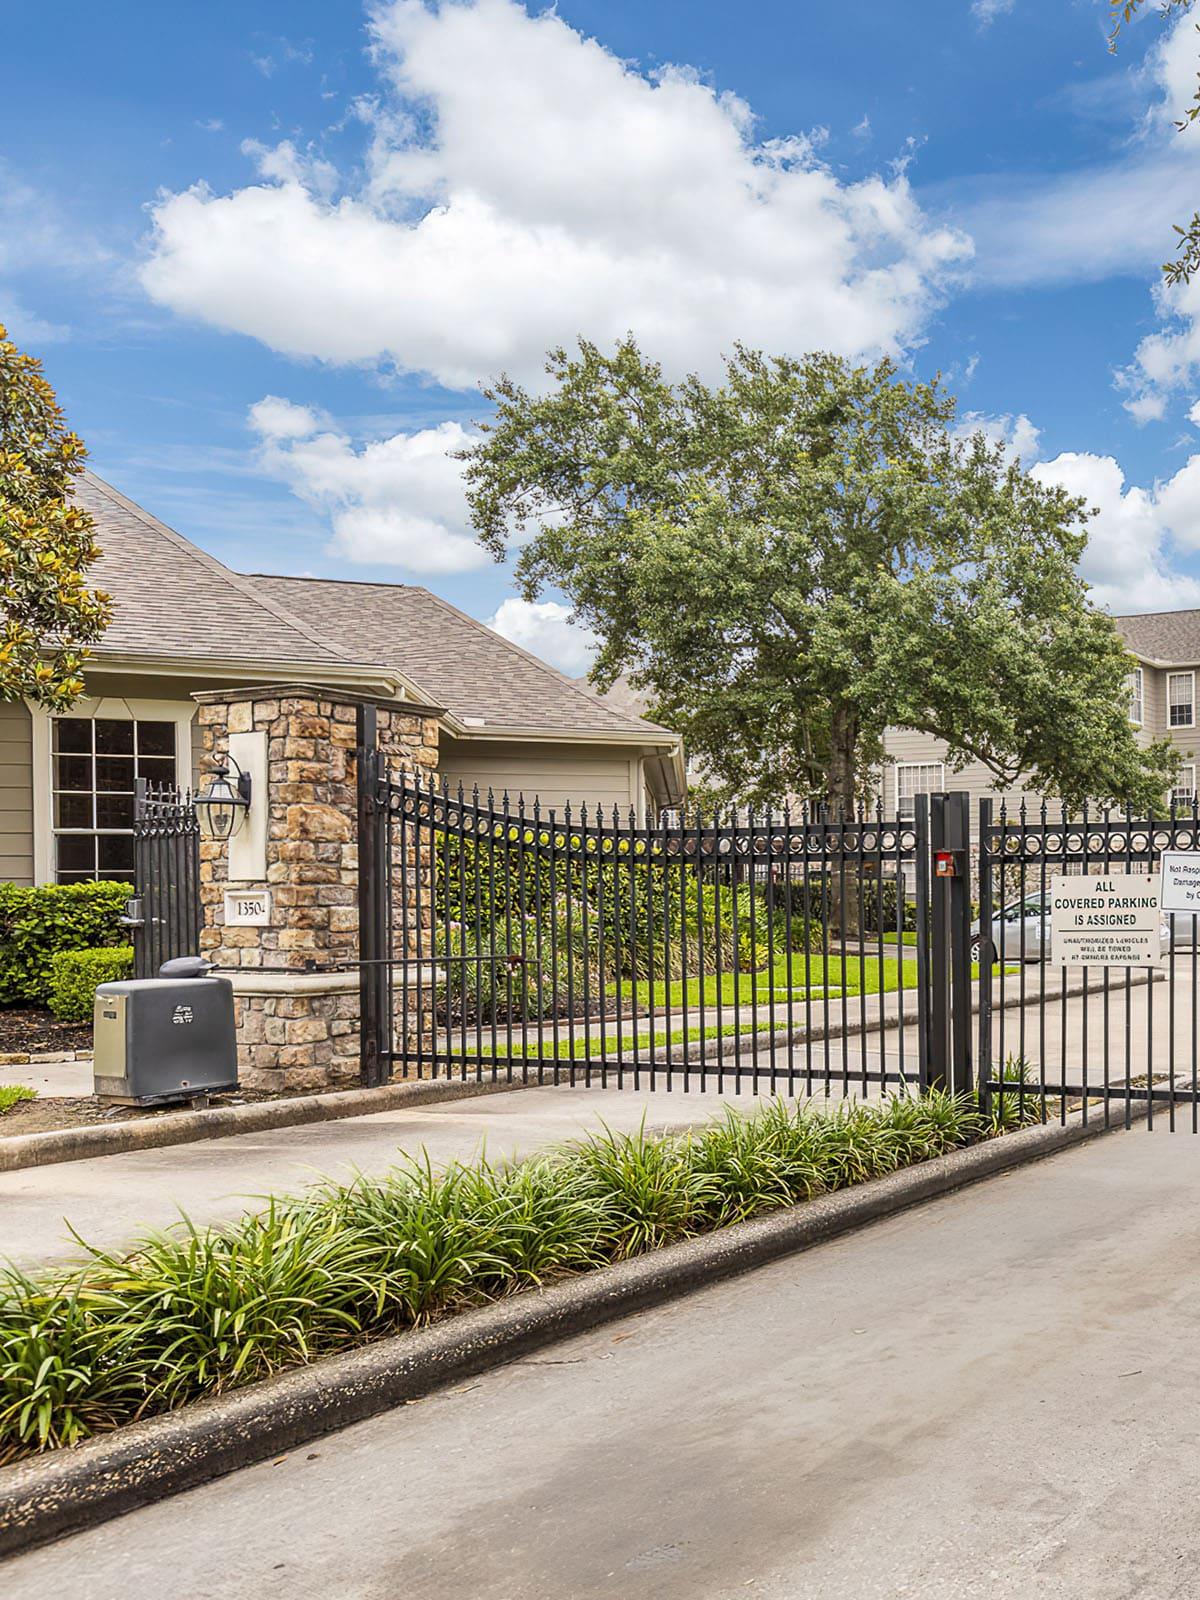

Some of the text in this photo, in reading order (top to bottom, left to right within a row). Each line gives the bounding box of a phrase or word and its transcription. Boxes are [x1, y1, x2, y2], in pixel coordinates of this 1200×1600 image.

[1170, 865, 1181, 873] Not
[1095, 881, 1116, 892] ALL
[1186, 892, 1195, 900] by
[1054, 897, 1158, 909] COVERED PARKING
[1074, 914, 1137, 925] IS ASSIGNED
